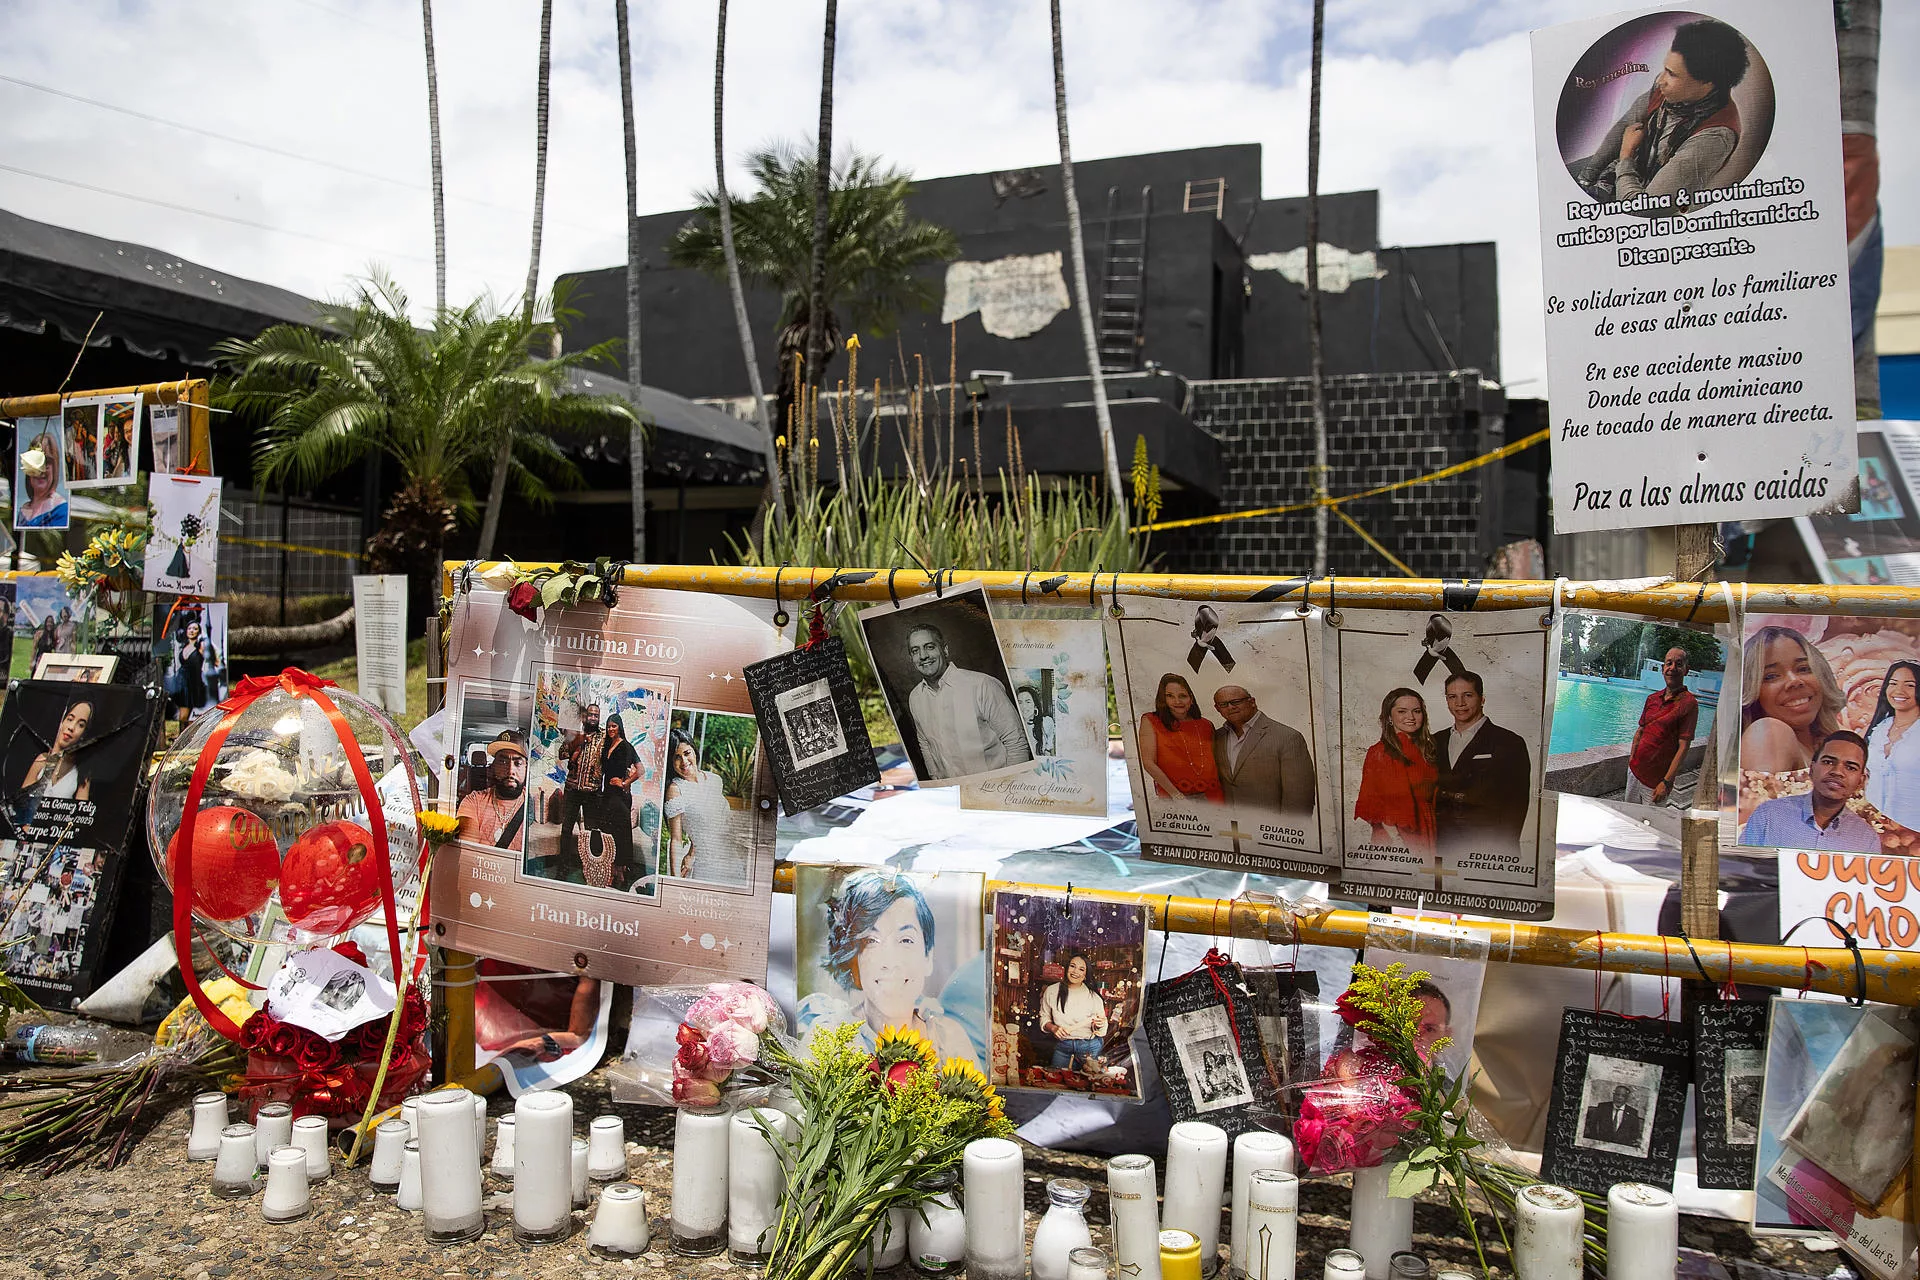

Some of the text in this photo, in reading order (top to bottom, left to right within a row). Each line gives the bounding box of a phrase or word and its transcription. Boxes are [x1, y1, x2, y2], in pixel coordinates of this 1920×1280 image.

[1575, 61, 1649, 89] Rey medina
[1567, 177, 1804, 222] Rey medina & movimiento
[1557, 200, 1819, 248] unidos por la Dominicanidad.
[1618, 237, 1755, 267] Dicen presente.
[1547, 271, 1838, 315] Se solidarizan con los familiares
[1594, 301, 1788, 337] de esas almas caídas.
[1585, 347, 1803, 382] En ese accidente masivo
[1587, 377, 1804, 409] Donde cada dominicano
[1561, 403, 1834, 442] fue tocado de manera directa.
[1573, 482, 1611, 512] Paz
[1619, 487, 1633, 508] a
[1640, 476, 1672, 507] las
[1679, 472, 1746, 504] almas
[539, 630, 678, 659] Su ultima Foto
[52, 799, 77, 815] Gómez
[78, 801, 97, 816] Feliz
[1162, 812, 1199, 822] JOANNA
[1155, 821, 1210, 832] DE GRULLÓN
[1259, 824, 1304, 837] EDUARDO
[1262, 832, 1305, 845] GRULLON
[475, 856, 503, 871] Tony
[1164, 846, 1181, 858] HAN
[1182, 848, 1198, 860] IDO
[1199, 850, 1219, 862] PERO
[1221, 852, 1233, 864] NO
[1235, 854, 1250, 866] LOS
[1251, 856, 1281, 870] HEMOS
[1283, 860, 1329, 875] OLVIDADO”
[1347, 851, 1424, 865] GRULLON SEGURA
[1357, 844, 1410, 854] ALEXANDRA
[1469, 852, 1520, 864] EDUARDO
[471, 867, 507, 884] Blanco
[1457, 860, 1536, 875] ESTRELLA CRUZ
[1356, 884, 1374, 897] HAN
[1377, 887, 1392, 899] IDO
[1395, 888, 1417, 901] PERO
[1420, 891, 1434, 903] NO
[1436, 893, 1452, 905] LOS
[1454, 895, 1487, 908] HEMOS
[1489, 898, 1542, 914] OLVIDADO”
[531, 903, 640, 937] ¡Tan Bellos!
[24, 978, 41, 987] todas
[42, 981, 53, 989] tus
[52, 983, 73, 992] metas
[1776, 1165, 1805, 1196] Malditos
[1803, 1190, 1823, 1209] sean
[1821, 1204, 1833, 1219] los
[1859, 1234, 1874, 1249] del
[1870, 1243, 1885, 1260] Jet
[1883, 1254, 1899, 1271] Set
